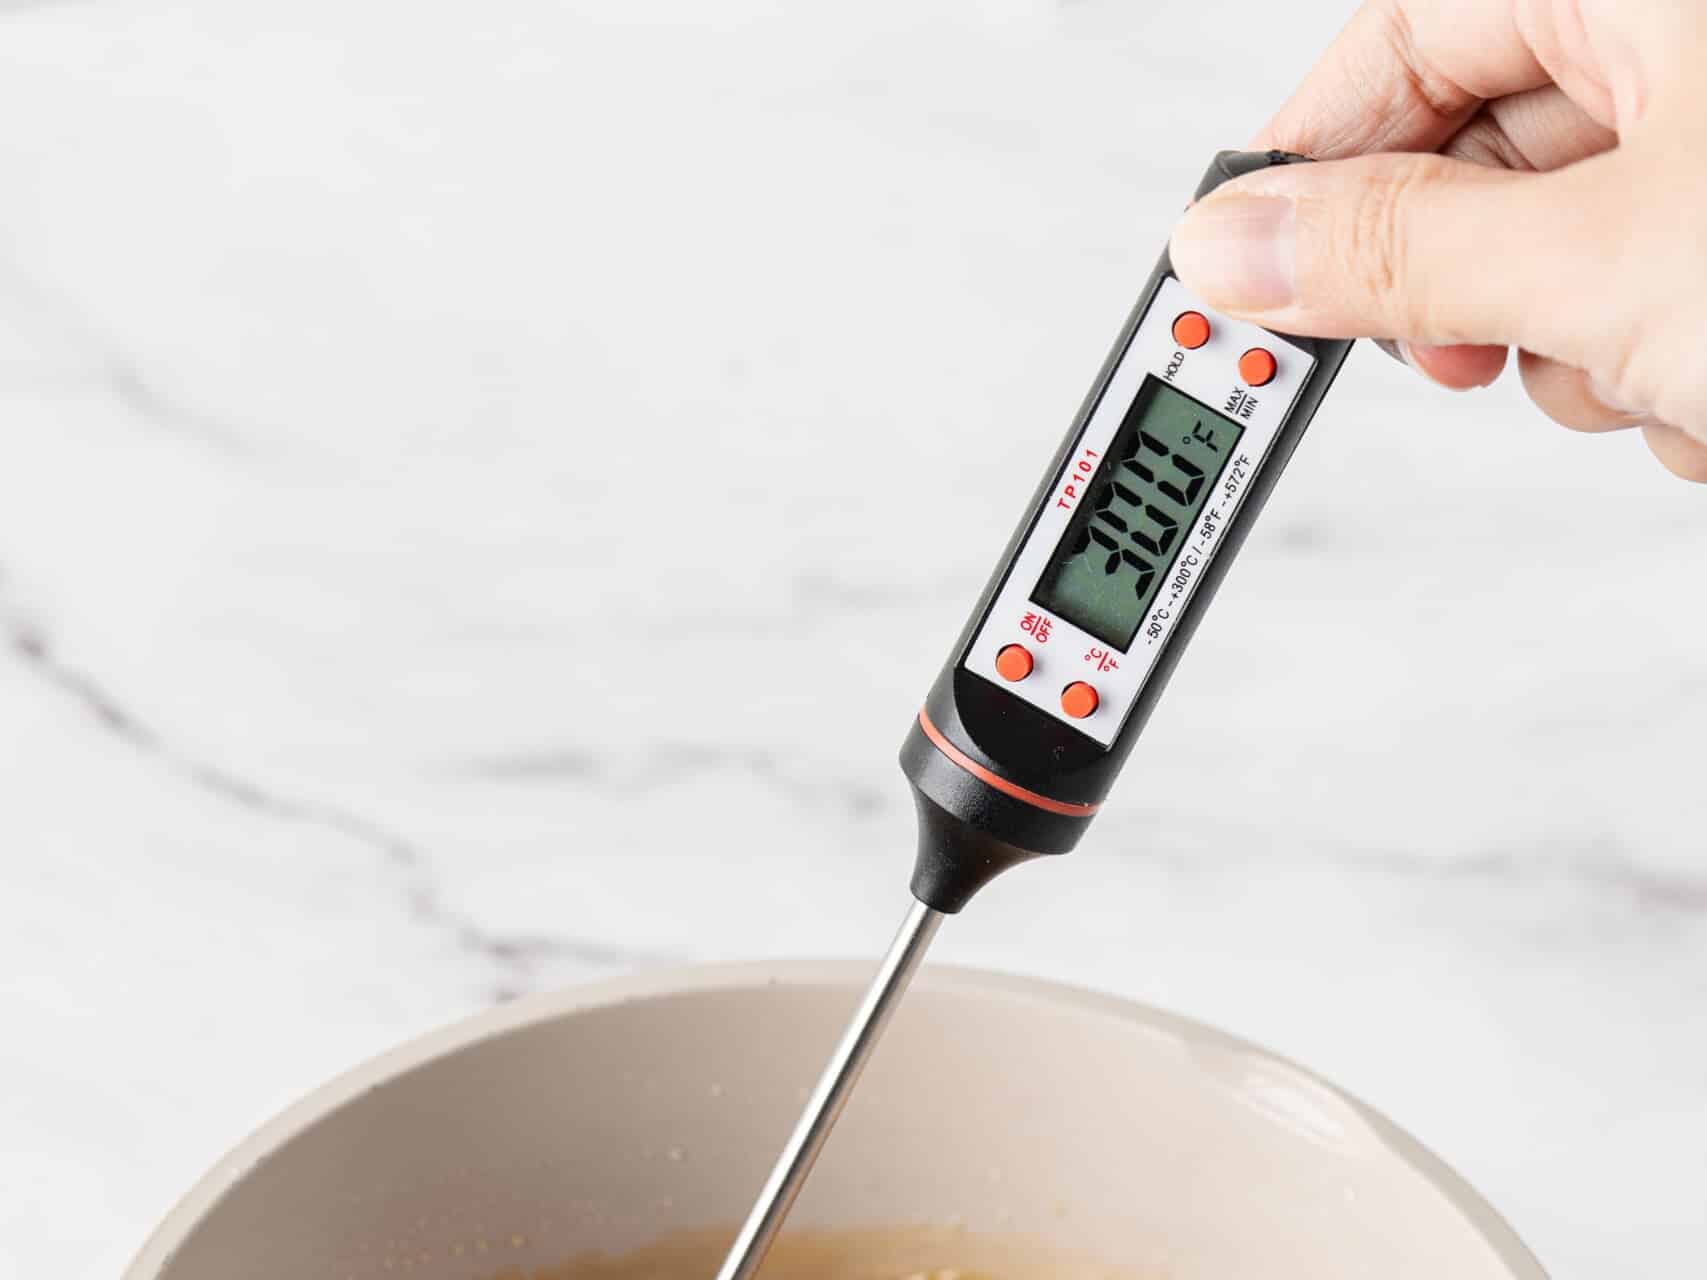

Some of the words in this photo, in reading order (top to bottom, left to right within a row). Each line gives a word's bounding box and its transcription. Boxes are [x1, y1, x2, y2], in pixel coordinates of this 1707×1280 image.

[1163, 351, 1185, 382] HOLD
[1224, 386, 1245, 413] MAX
[1240, 397, 1260, 420] MIN
[1056, 448, 1099, 511] TP101
[1072, 430, 1205, 600] 300
[1020, 611, 1037, 631] ON
[1035, 617, 1053, 643] OFF
